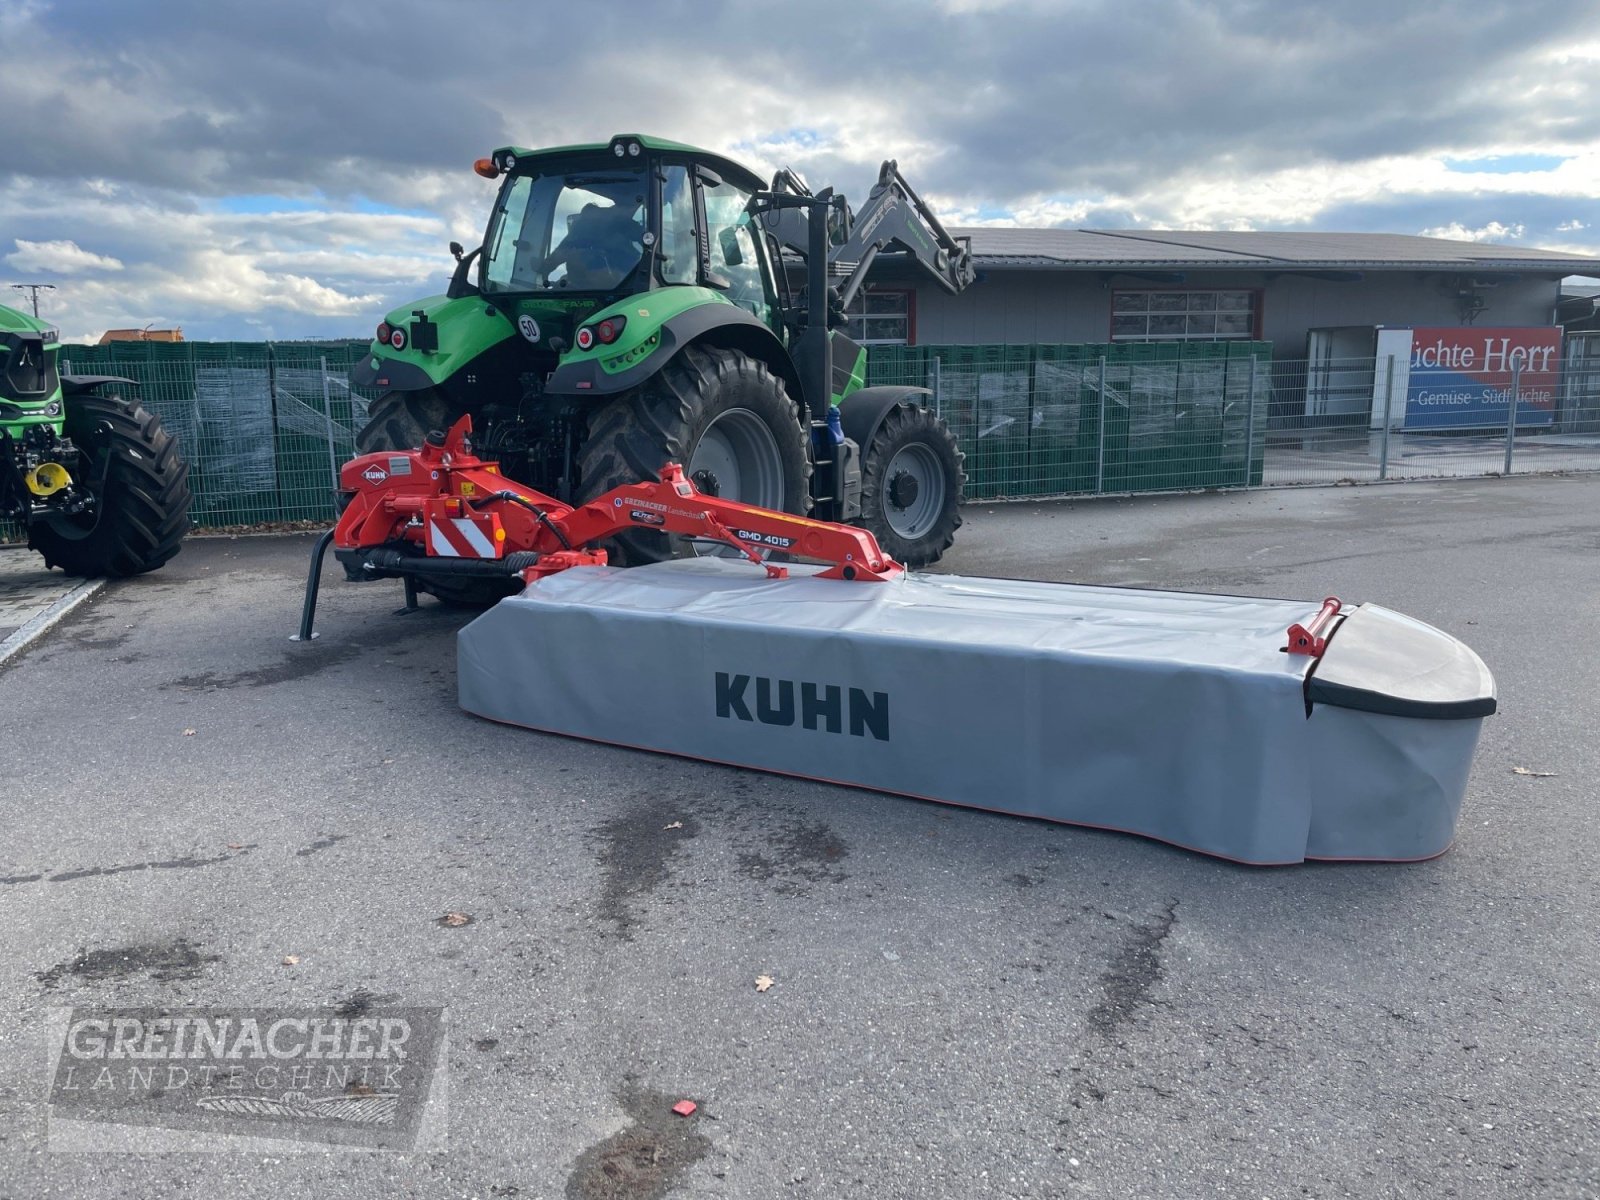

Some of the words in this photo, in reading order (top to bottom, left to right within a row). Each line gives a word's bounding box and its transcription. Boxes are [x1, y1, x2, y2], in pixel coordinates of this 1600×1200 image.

[521, 321, 537, 338] 50
[1483, 337, 1556, 373] Herr
[1418, 390, 1472, 406] Gemüse
[1481, 388, 1551, 404] Südfüchte
[365, 471, 386, 479] KUHN
[624, 497, 667, 512] GREINACHER
[738, 529, 761, 541] GMD
[764, 535, 789, 547] 4015
[715, 671, 890, 742] KUHN
